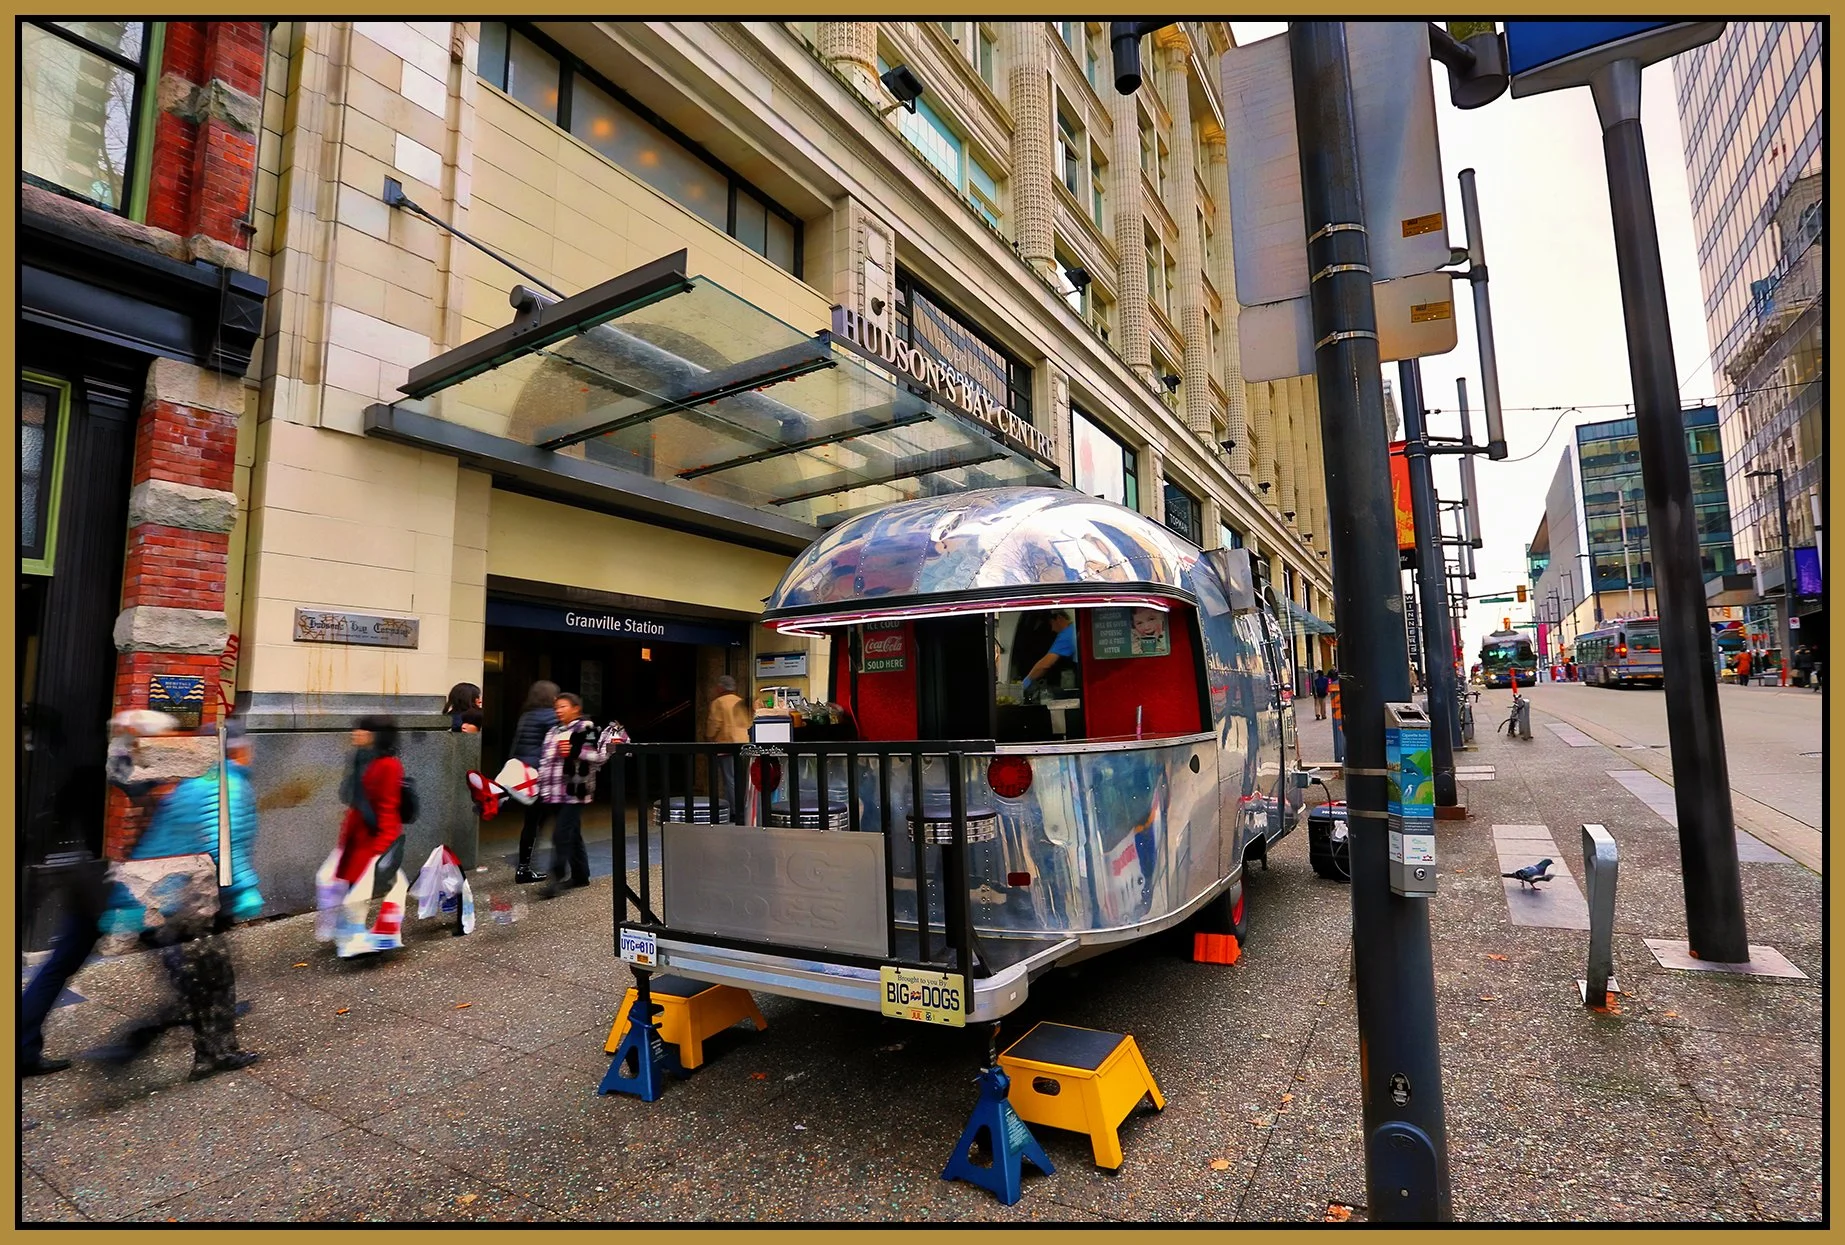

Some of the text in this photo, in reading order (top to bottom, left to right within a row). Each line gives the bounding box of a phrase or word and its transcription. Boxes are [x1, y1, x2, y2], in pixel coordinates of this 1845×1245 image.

[937, 338, 989, 385] TOPSHOP
[842, 305, 1055, 460] HUDSON'S BAY CENTRE
[565, 611, 664, 635] Granville Station
[867, 659, 904, 670] SOLD HERE
[897, 974, 920, 984] Brought
[938, 979, 948, 987] By
[887, 982, 960, 1011] BIG DOGS
